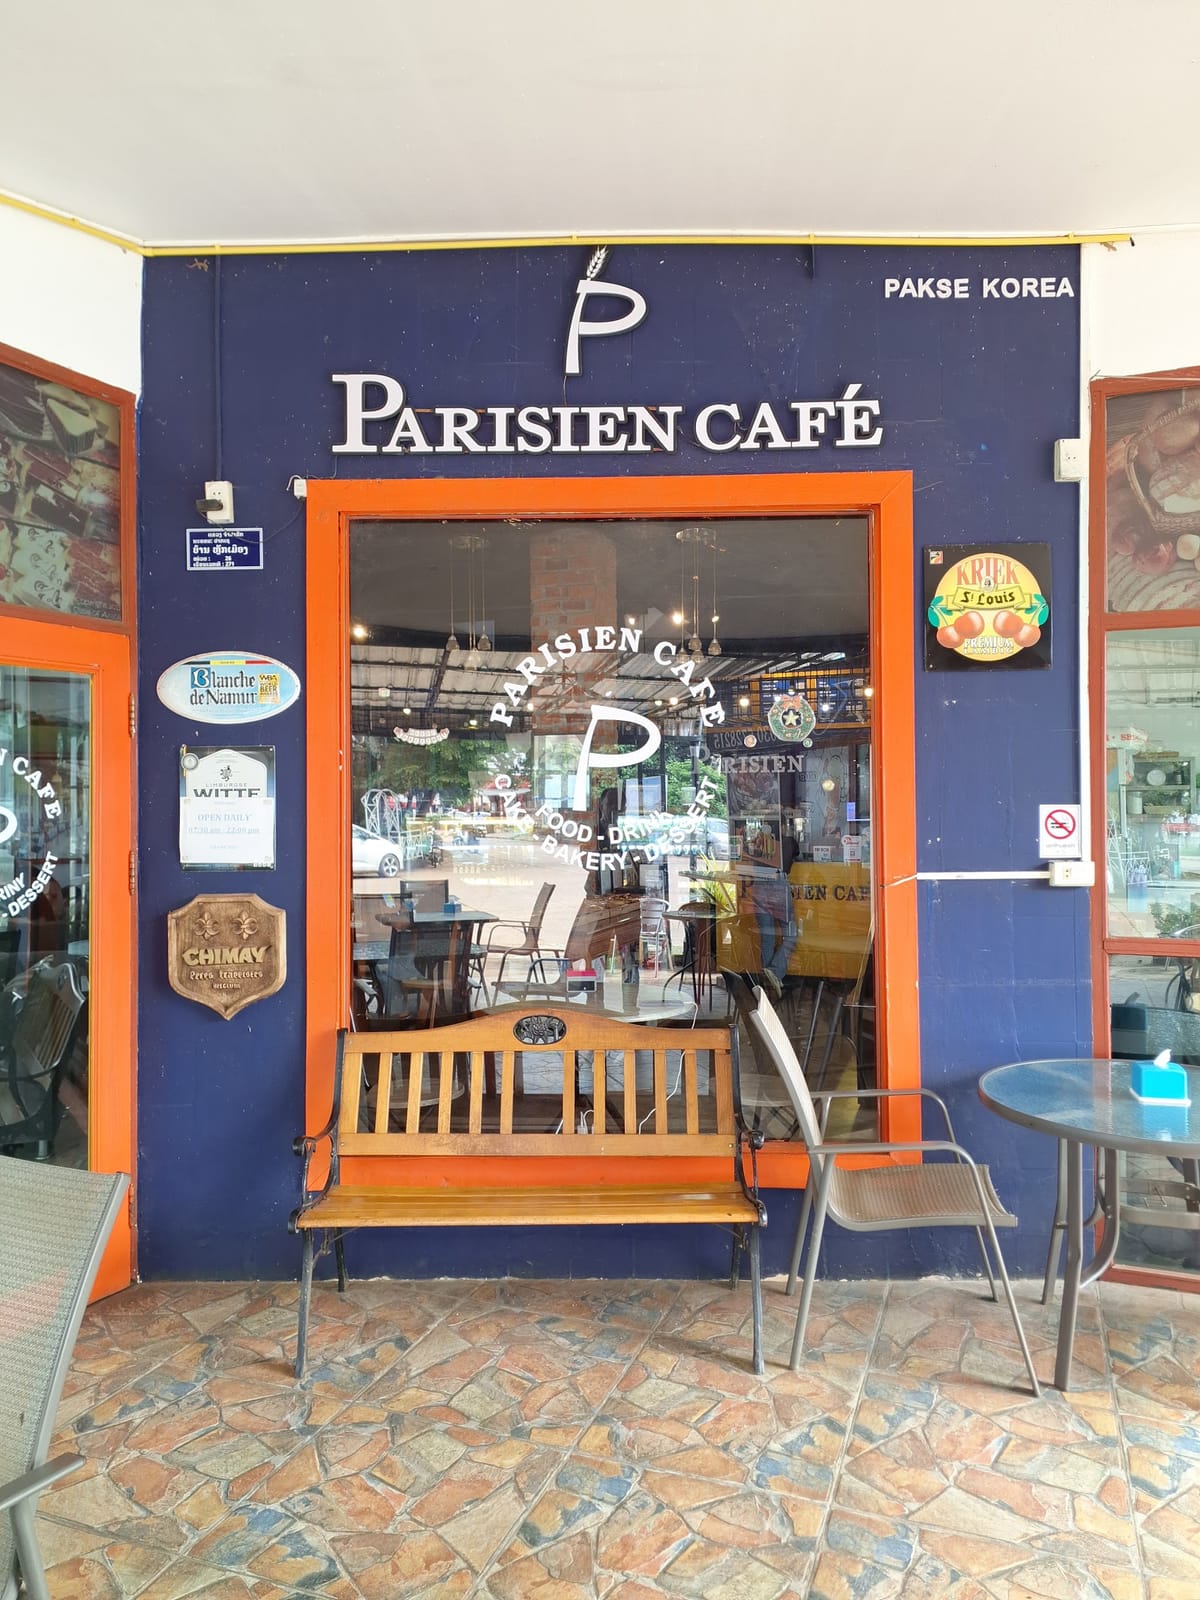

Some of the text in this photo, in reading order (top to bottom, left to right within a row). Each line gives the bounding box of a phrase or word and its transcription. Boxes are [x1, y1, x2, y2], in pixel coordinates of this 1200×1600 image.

[884, 277, 1075, 298] PAKSE KOREA
[565, 279, 648, 375] P
[331, 373, 884, 453] PARISIEN CAFÉ
[956, 557, 1020, 586] KRIEK
[977, 591, 1016, 606] Louis
[963, 634, 1015, 649] PREMIUM
[191, 666, 256, 689] Blanche
[489, 625, 643, 728] PARISIEN
[653, 640, 726, 728] CAFE
[573, 704, 662, 812] P
[12, 756, 62, 819] CAFE
[198, 813, 252, 822] OPEN DAILY
[494, 772, 536, 834] CAKE
[541, 834, 629, 871] BAKERY
[643, 774, 718, 862] DESSERT
[535, 803, 593, 842] FOOD
[8, 851, 58, 917] DESSERT
[182, 946, 267, 967] CHIMAY
